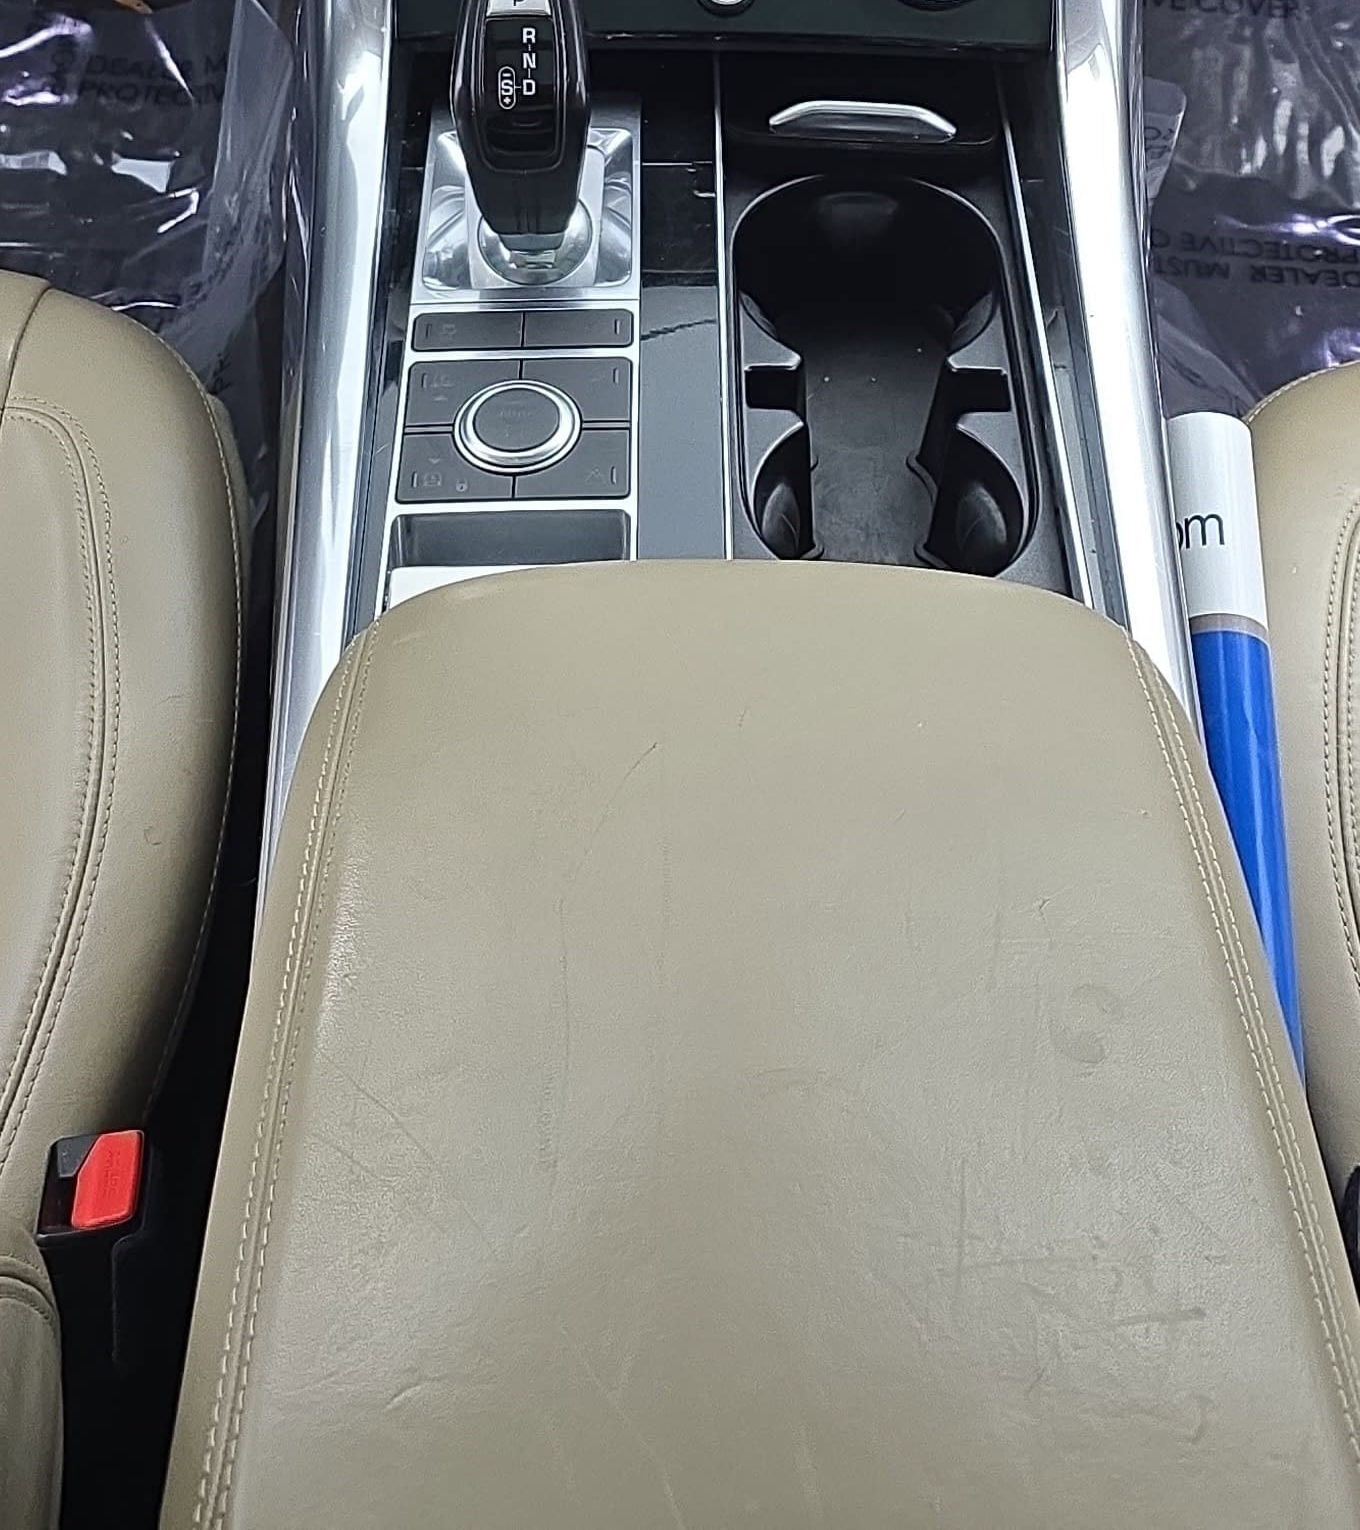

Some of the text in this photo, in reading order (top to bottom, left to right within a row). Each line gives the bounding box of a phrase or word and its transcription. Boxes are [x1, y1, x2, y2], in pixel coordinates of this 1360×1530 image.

[522, 27, 536, 44] R
[522, 52, 536, 69] N
[500, 79, 514, 96] S
[522, 79, 536, 96] D
[1180, 230, 1360, 267] PROTECTIVE
